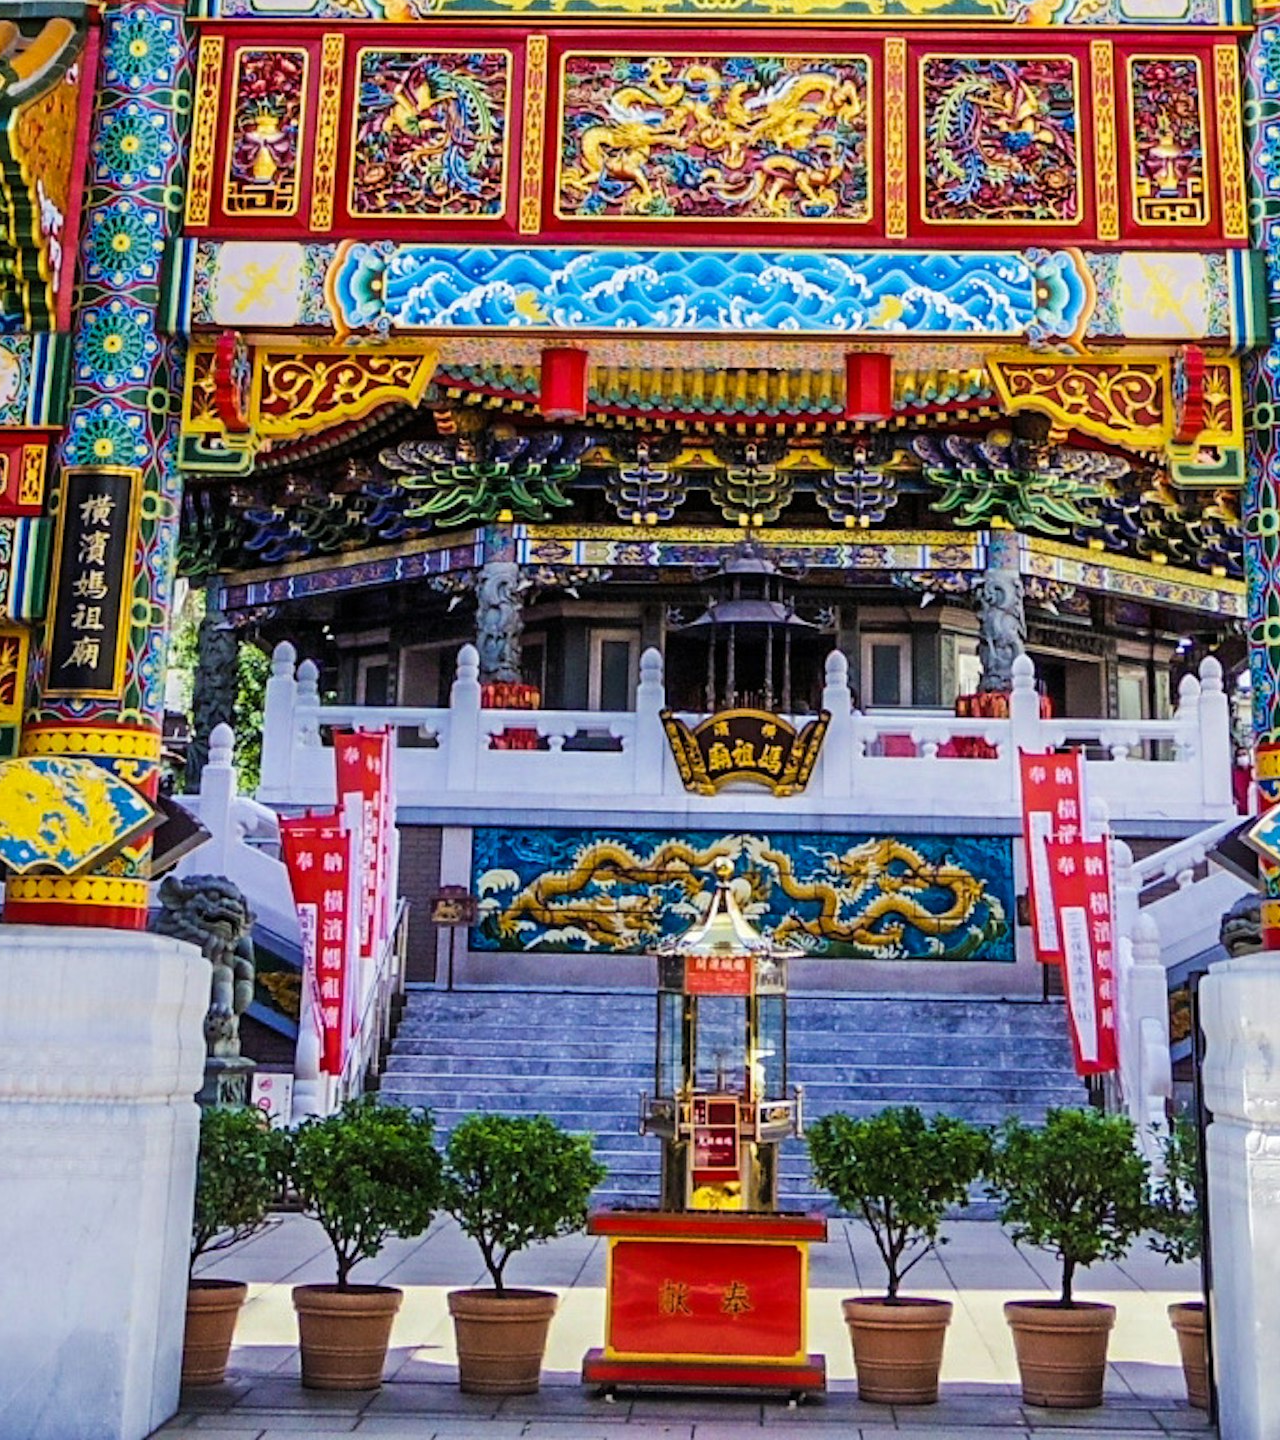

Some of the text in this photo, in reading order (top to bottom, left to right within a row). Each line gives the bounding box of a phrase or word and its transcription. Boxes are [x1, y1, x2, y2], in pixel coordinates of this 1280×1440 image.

[1028, 765, 1074, 786] 奉納
[295, 851, 343, 873] 奉納
[1057, 856, 1105, 877] 奉納
